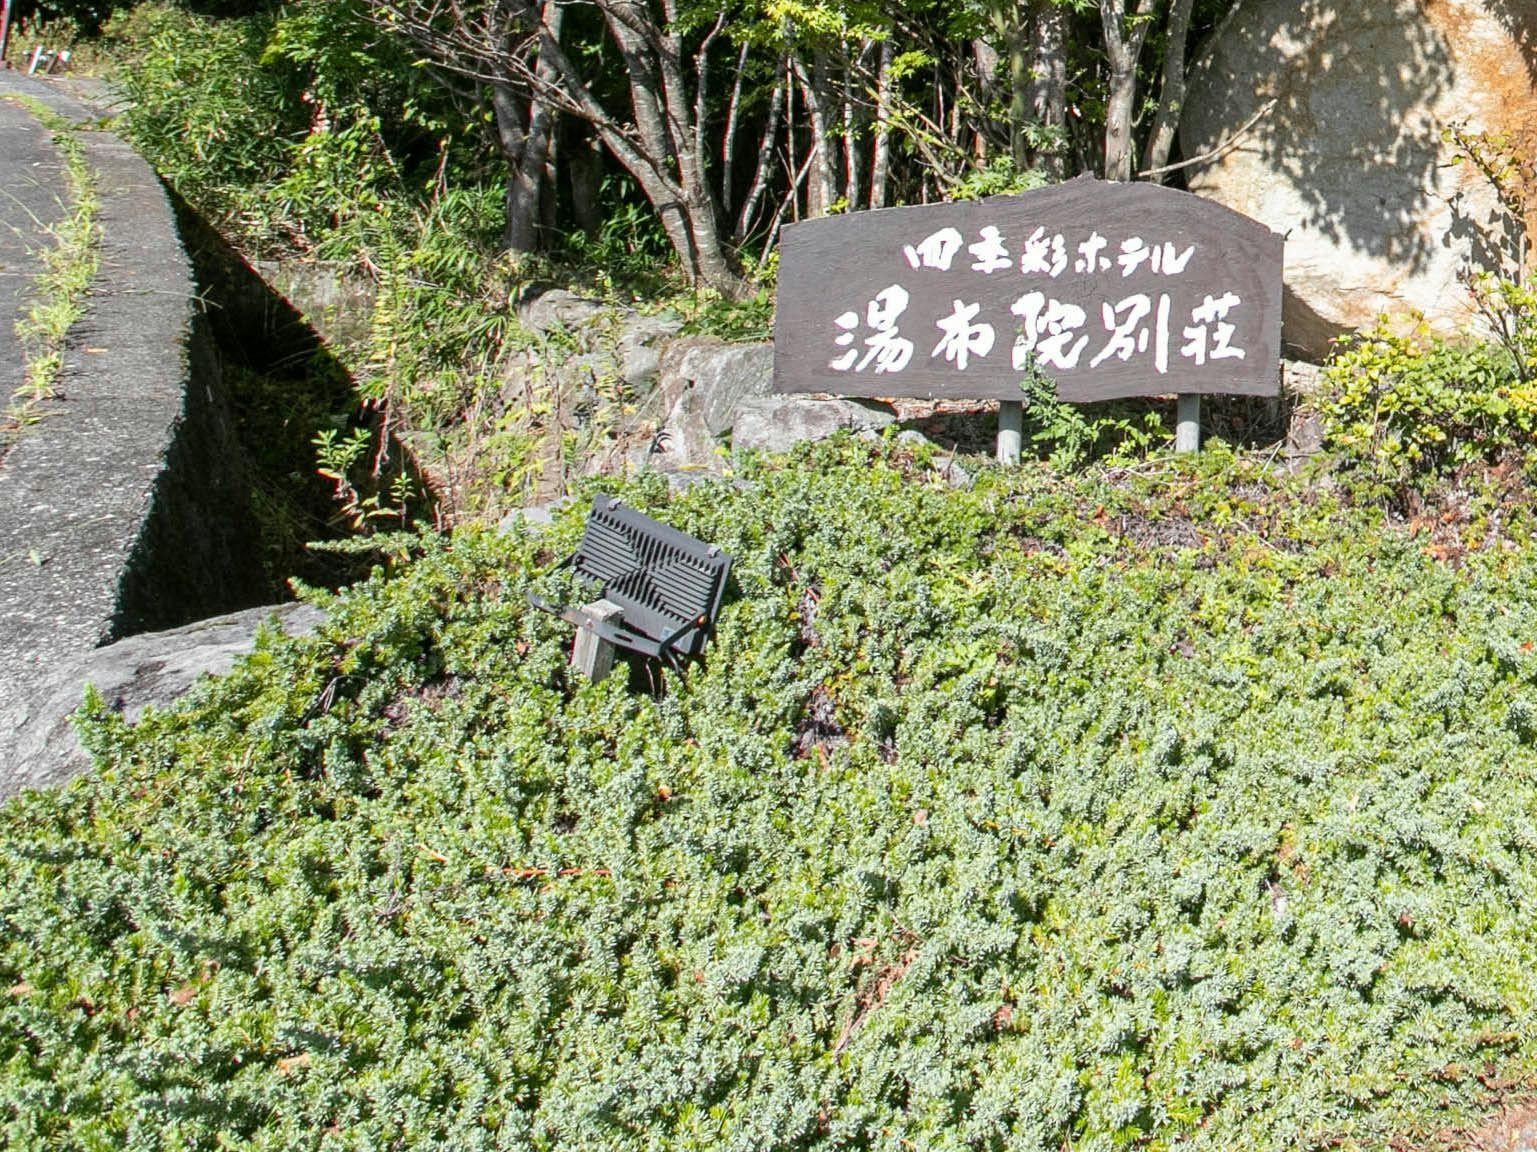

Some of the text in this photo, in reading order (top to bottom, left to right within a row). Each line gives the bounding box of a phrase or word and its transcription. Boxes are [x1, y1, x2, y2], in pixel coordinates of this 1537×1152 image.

[903, 225, 1195, 278] 四季彩ホテル
[828, 283, 1246, 375] 湯布院別荘
